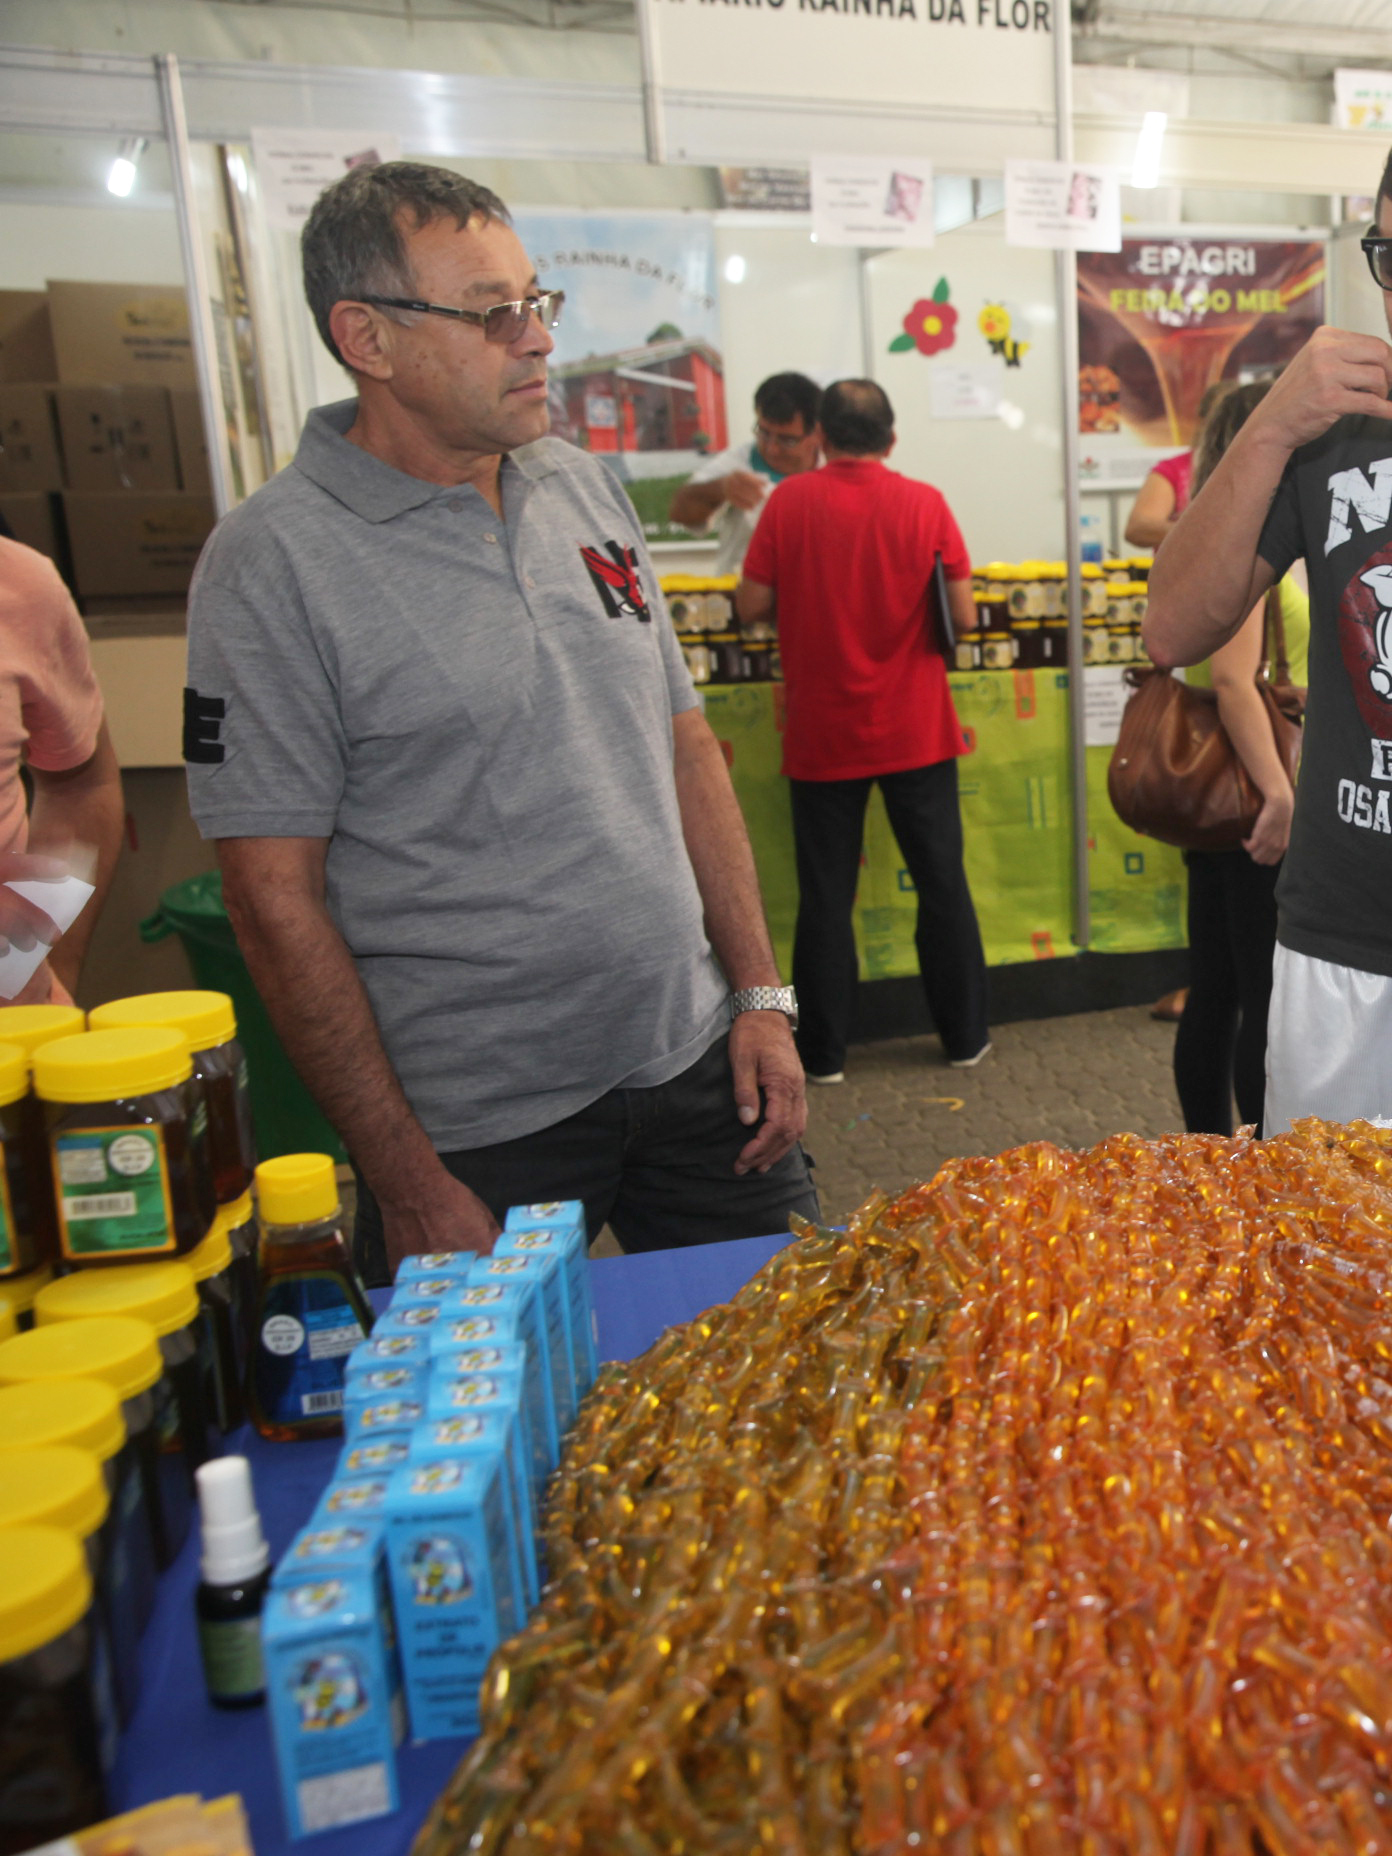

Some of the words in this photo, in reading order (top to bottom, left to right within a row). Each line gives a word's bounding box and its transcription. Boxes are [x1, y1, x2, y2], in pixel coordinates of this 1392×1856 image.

[928, 0, 965, 24] DA
[977, 0, 1052, 32] FLOR
[1139, 245, 1257, 277] EPAGRI
[1109, 287, 1185, 313] FEIRA
[1191, 288, 1232, 313] DO
[1236, 289, 1289, 314] MEL
